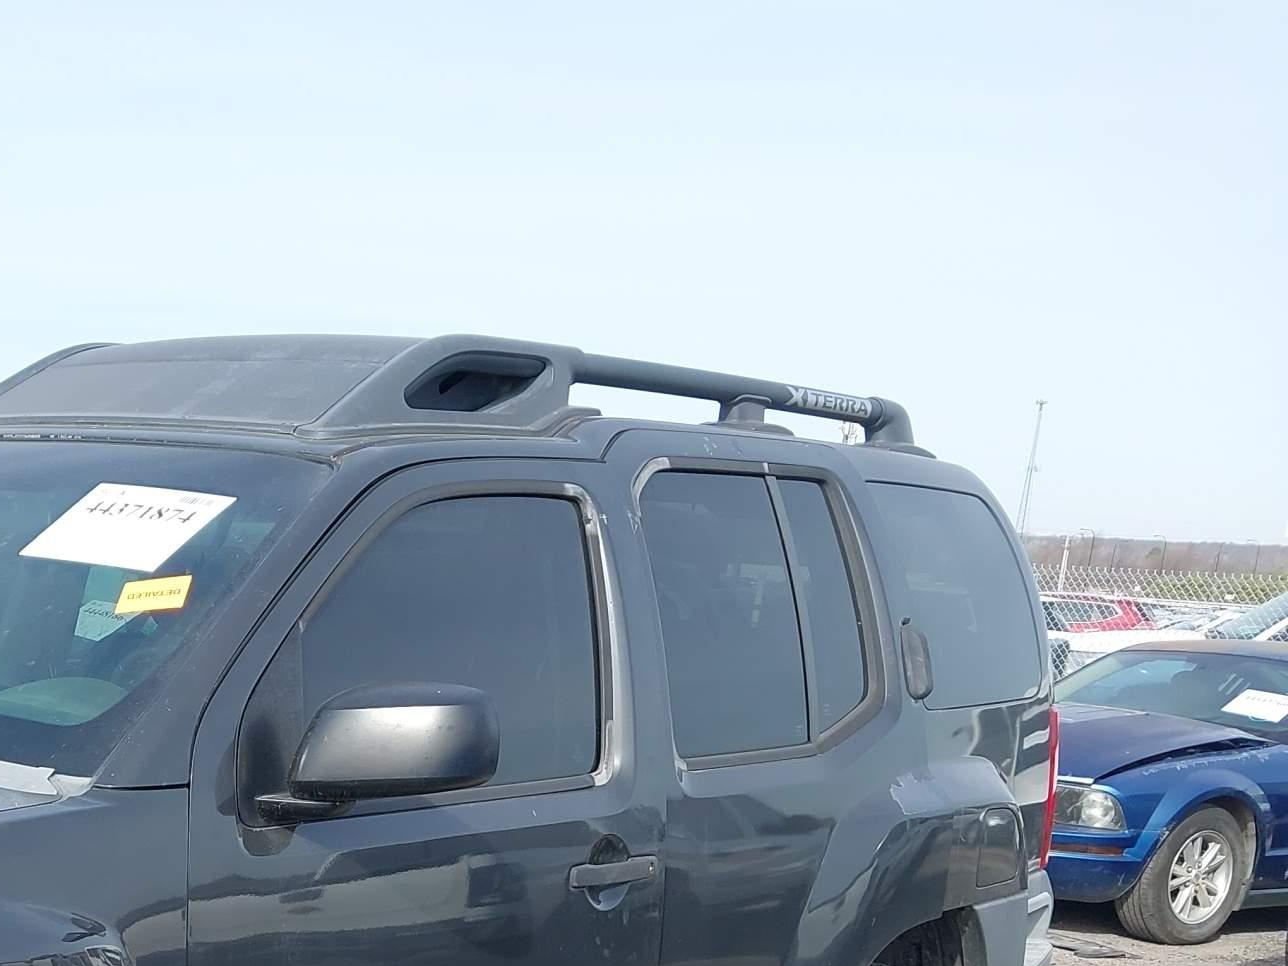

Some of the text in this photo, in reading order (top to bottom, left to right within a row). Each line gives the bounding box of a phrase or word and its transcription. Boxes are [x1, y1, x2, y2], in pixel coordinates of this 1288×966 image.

[785, 385, 871, 417] XTERRA
[87, 501, 197, 523] 44371874
[127, 588, 182, 600] DETAILED
